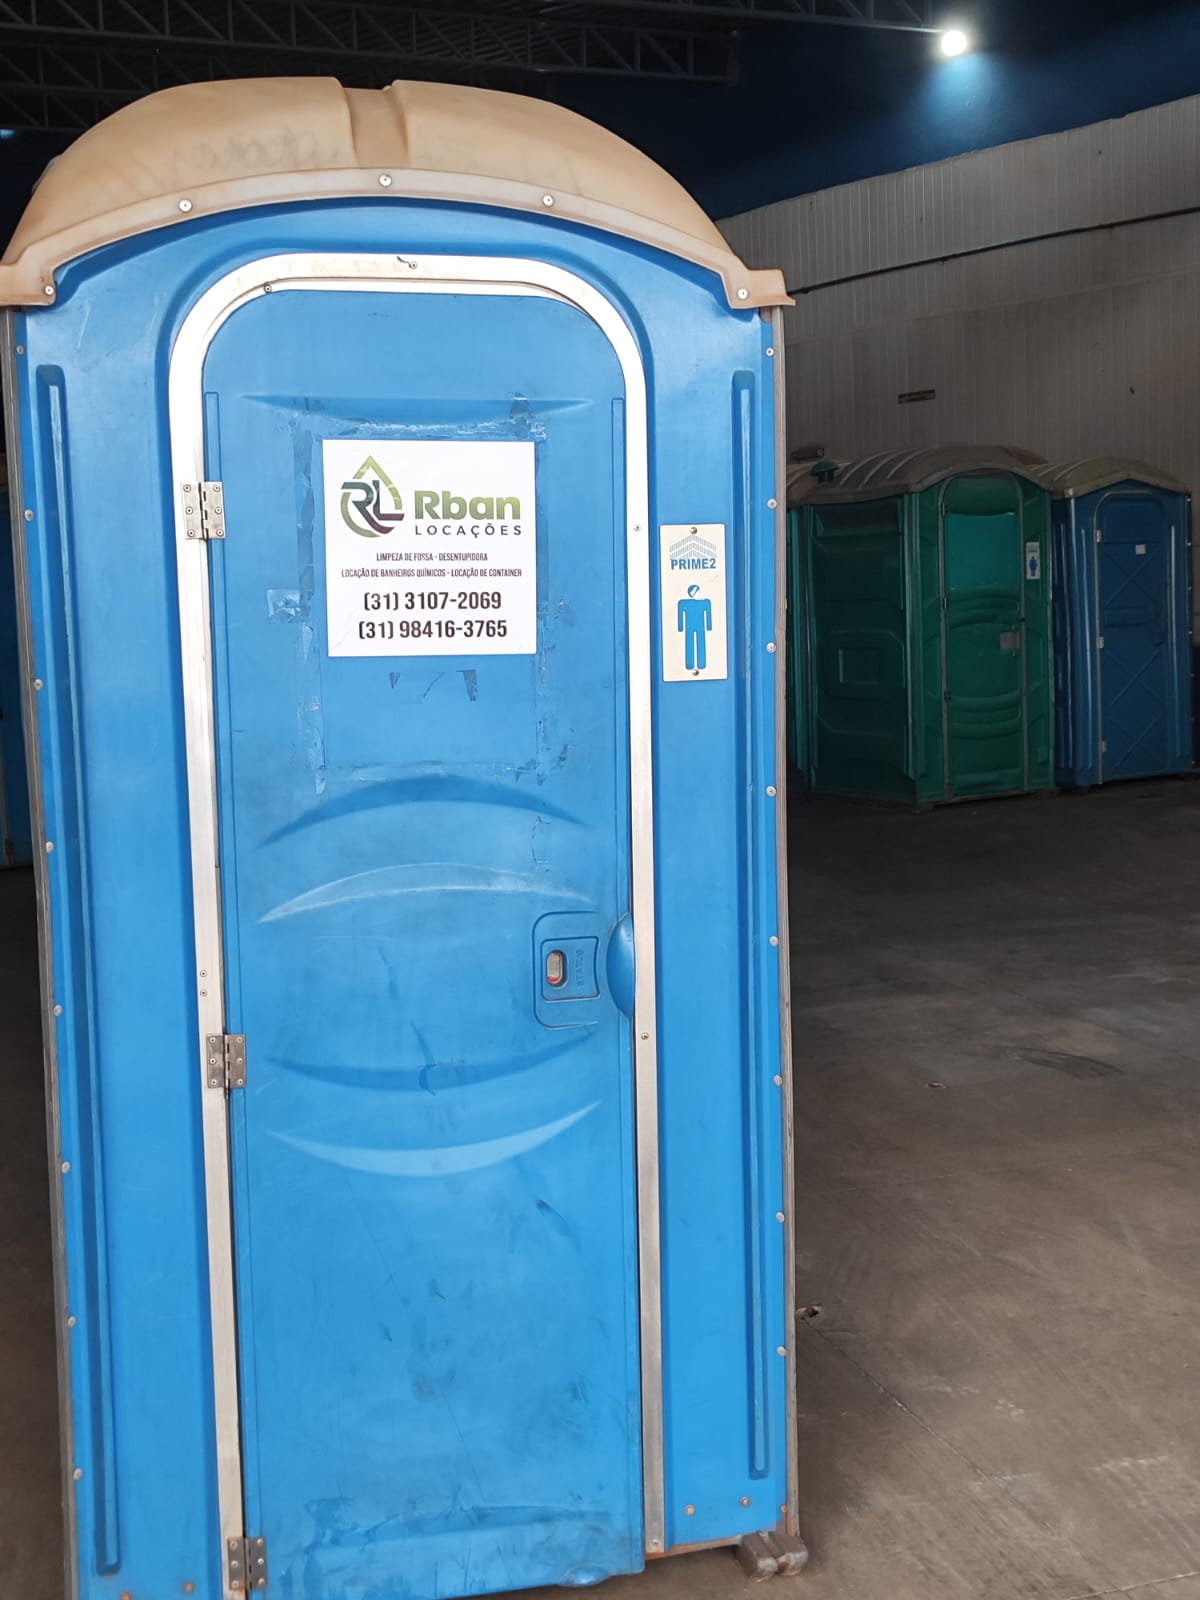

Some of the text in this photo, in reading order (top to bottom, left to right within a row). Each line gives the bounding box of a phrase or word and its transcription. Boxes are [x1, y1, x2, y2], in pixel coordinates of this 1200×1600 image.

[414, 490, 521, 520] Rban
[414, 523, 522, 539] LOCAÇÕES
[376, 552, 403, 562] LIMPEZA
[404, 552, 413, 562] DE
[413, 552, 434, 562] FOSSA
[438, 552, 489, 562] DESENTUPIDORA
[670, 557, 717, 570] PRIME2
[341, 567, 370, 579] LOCAÇÃO
[370, 568, 379, 578] DE
[380, 568, 416, 578] BANHEIROS
[416, 567, 446, 578] QUÍMICOS
[451, 567, 479, 579] LOCAÇÃO
[479, 568, 488, 578] DE
[488, 568, 523, 578] CONTAINER
[363, 591, 502, 612] (31) 3107-2069
[358, 619, 508, 640] (31) 98416-3765
